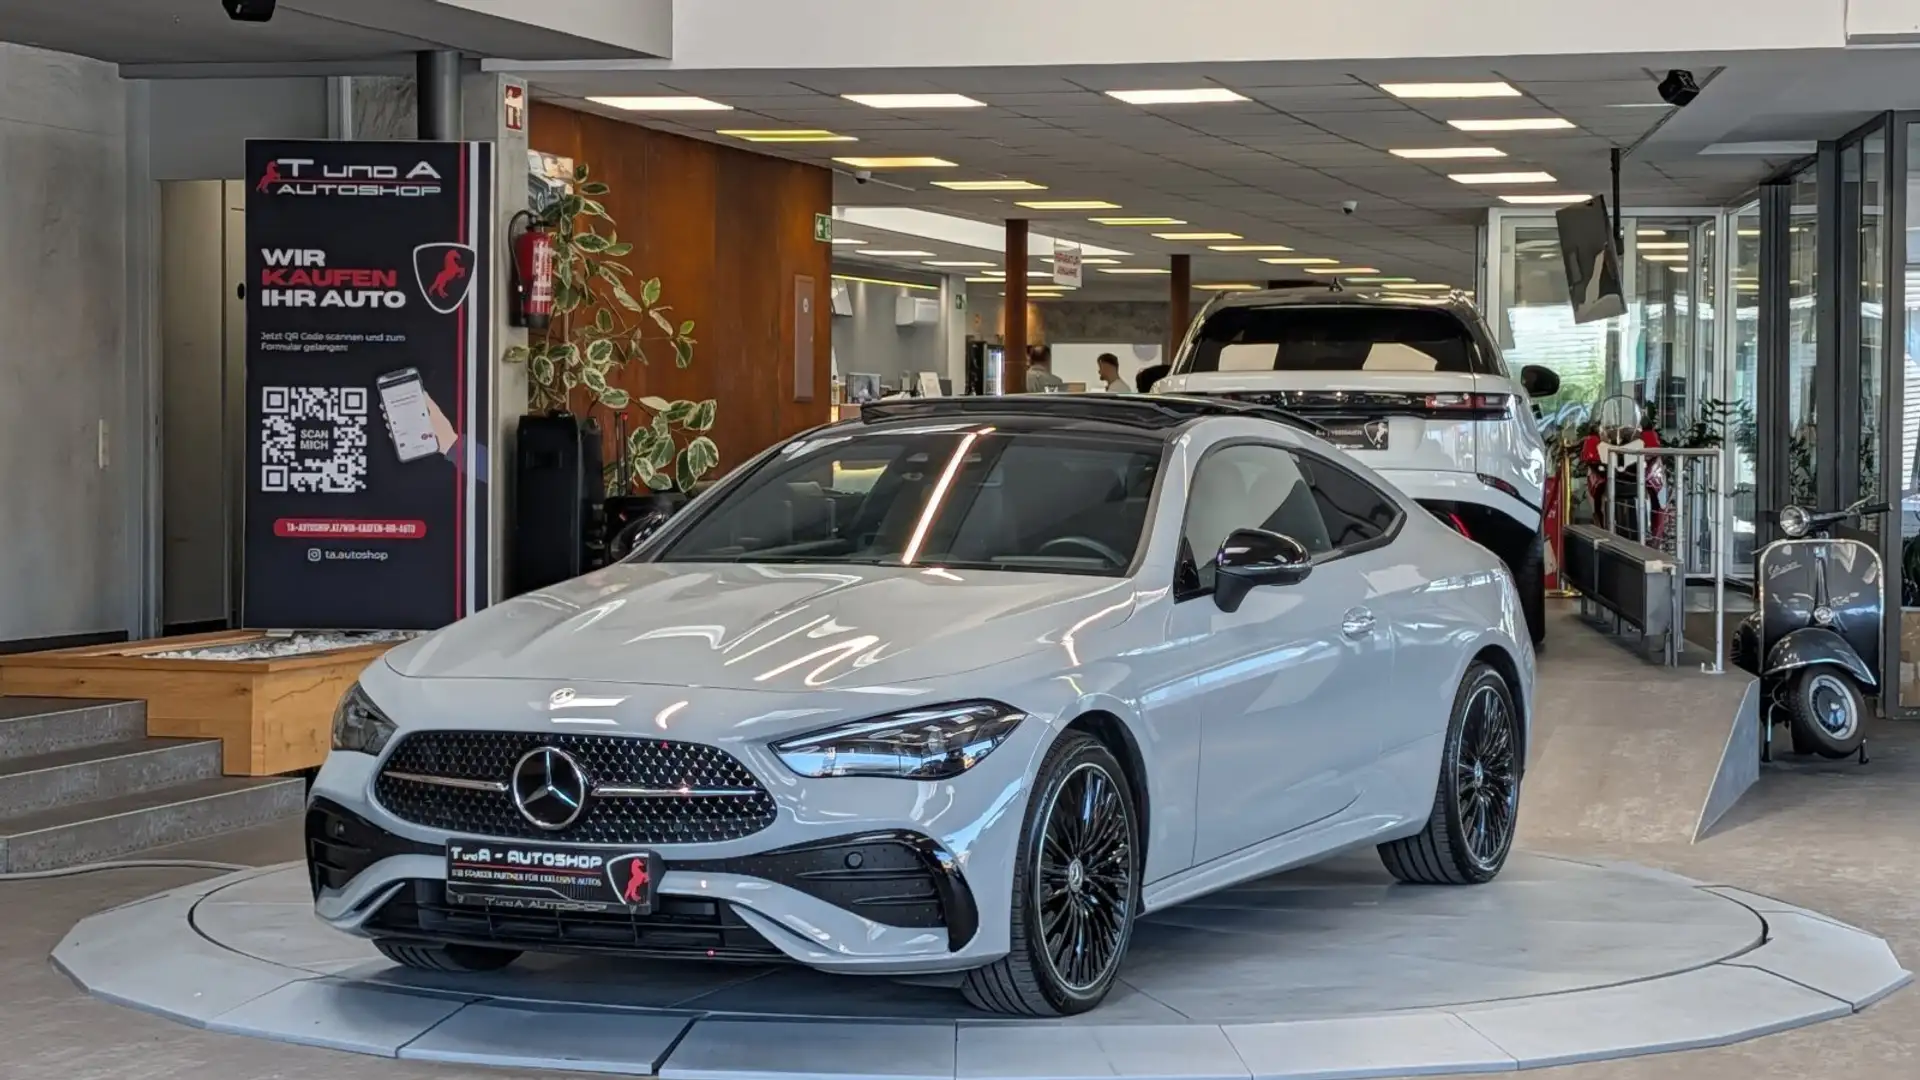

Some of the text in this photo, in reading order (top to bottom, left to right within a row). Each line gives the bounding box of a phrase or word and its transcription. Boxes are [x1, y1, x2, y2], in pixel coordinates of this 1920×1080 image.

[277, 159, 314, 177] T
[405, 161, 442, 179] A
[276, 184, 442, 197] AUTOSHOP
[261, 248, 326, 267] WIR
[261, 269, 397, 288] KAUFEN
[261, 289, 406, 309] IHR AUTO
[260, 331, 406, 342] Jetzt QR Code scannen und zum
[260, 342, 302, 351] Formular
[300, 429, 329, 440] SCAN
[300, 440, 329, 450] MICH
[325, 550, 389, 561] ta.autoshop
[507, 850, 603, 869] AUTOSHOP
